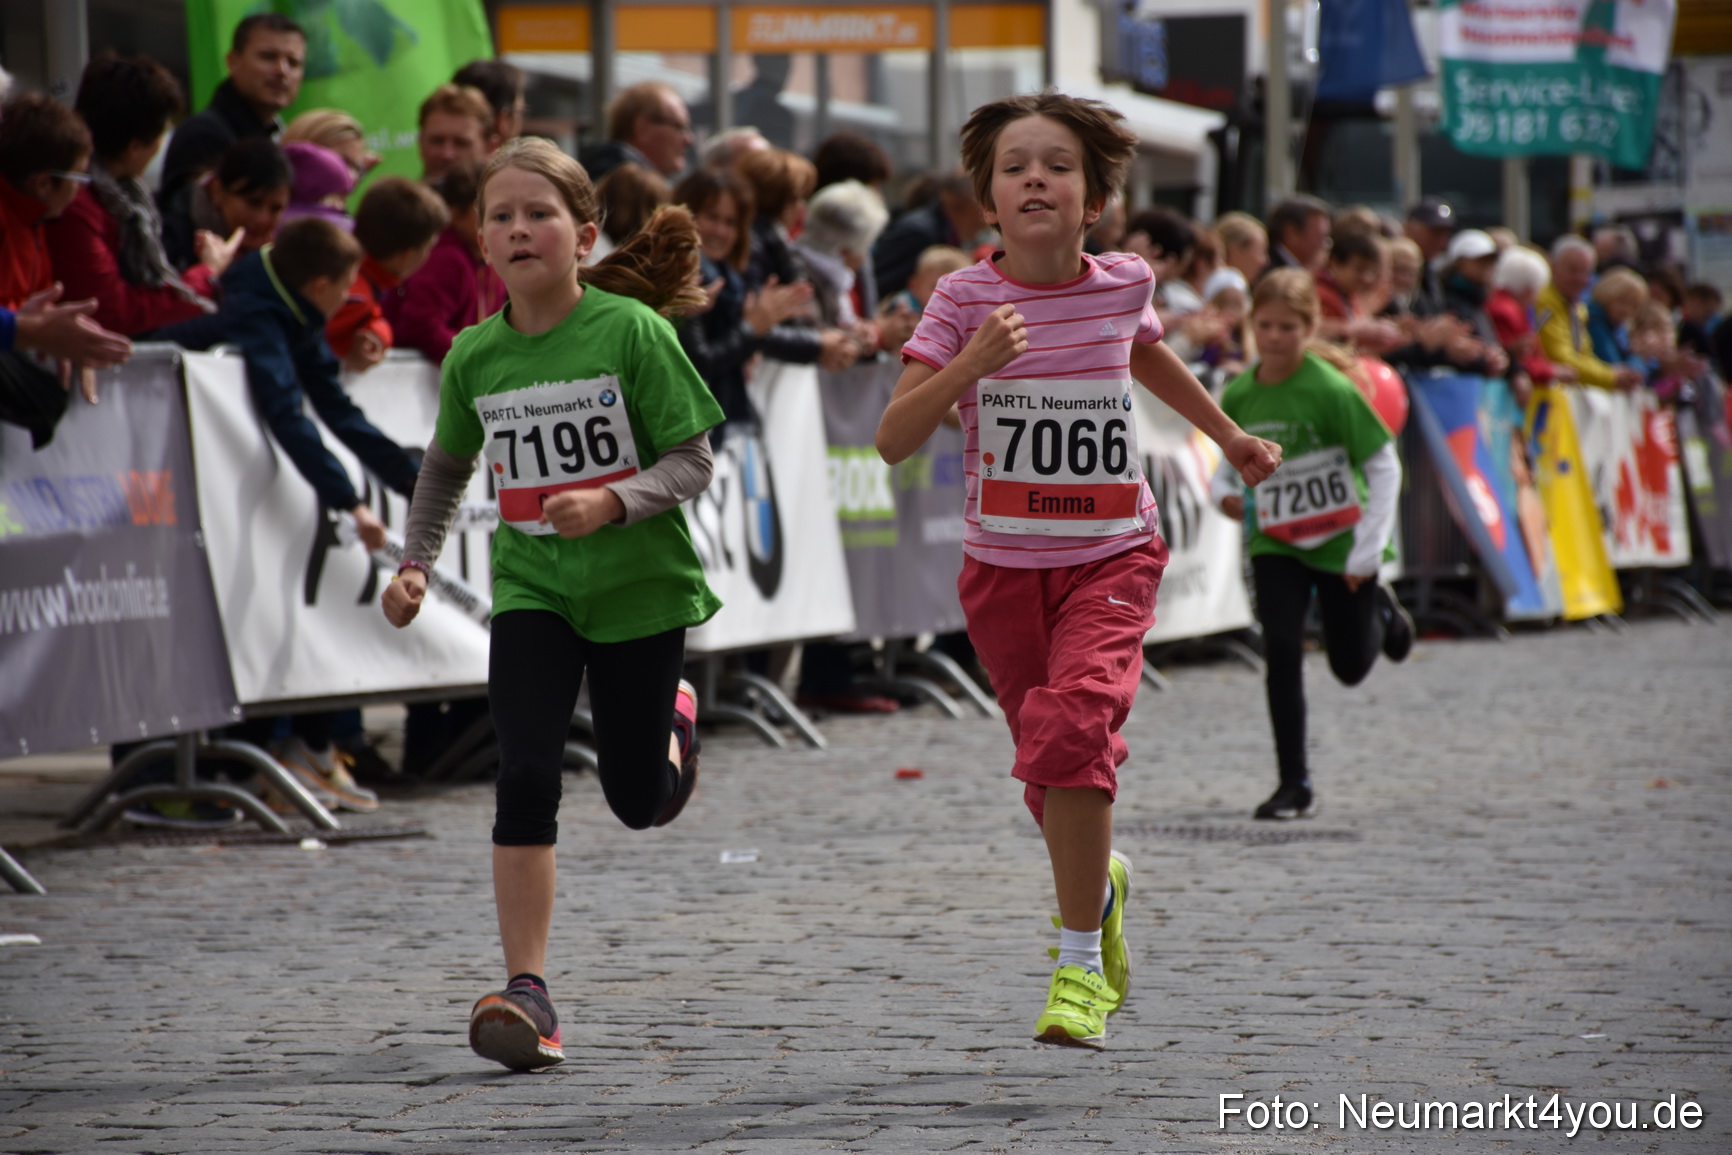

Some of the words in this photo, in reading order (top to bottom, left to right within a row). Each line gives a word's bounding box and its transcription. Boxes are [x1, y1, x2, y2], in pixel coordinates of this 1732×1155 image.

[483, 406, 521, 424] PARTL
[524, 397, 594, 418] Neumarkt
[981, 393, 1037, 410] PARTL
[1041, 395, 1118, 410] Neumarkt
[493, 416, 620, 480] 7196
[996, 417, 1128, 476] 7066
[1028, 490, 1096, 514] Emma
[1263, 470, 1347, 518] 7206
